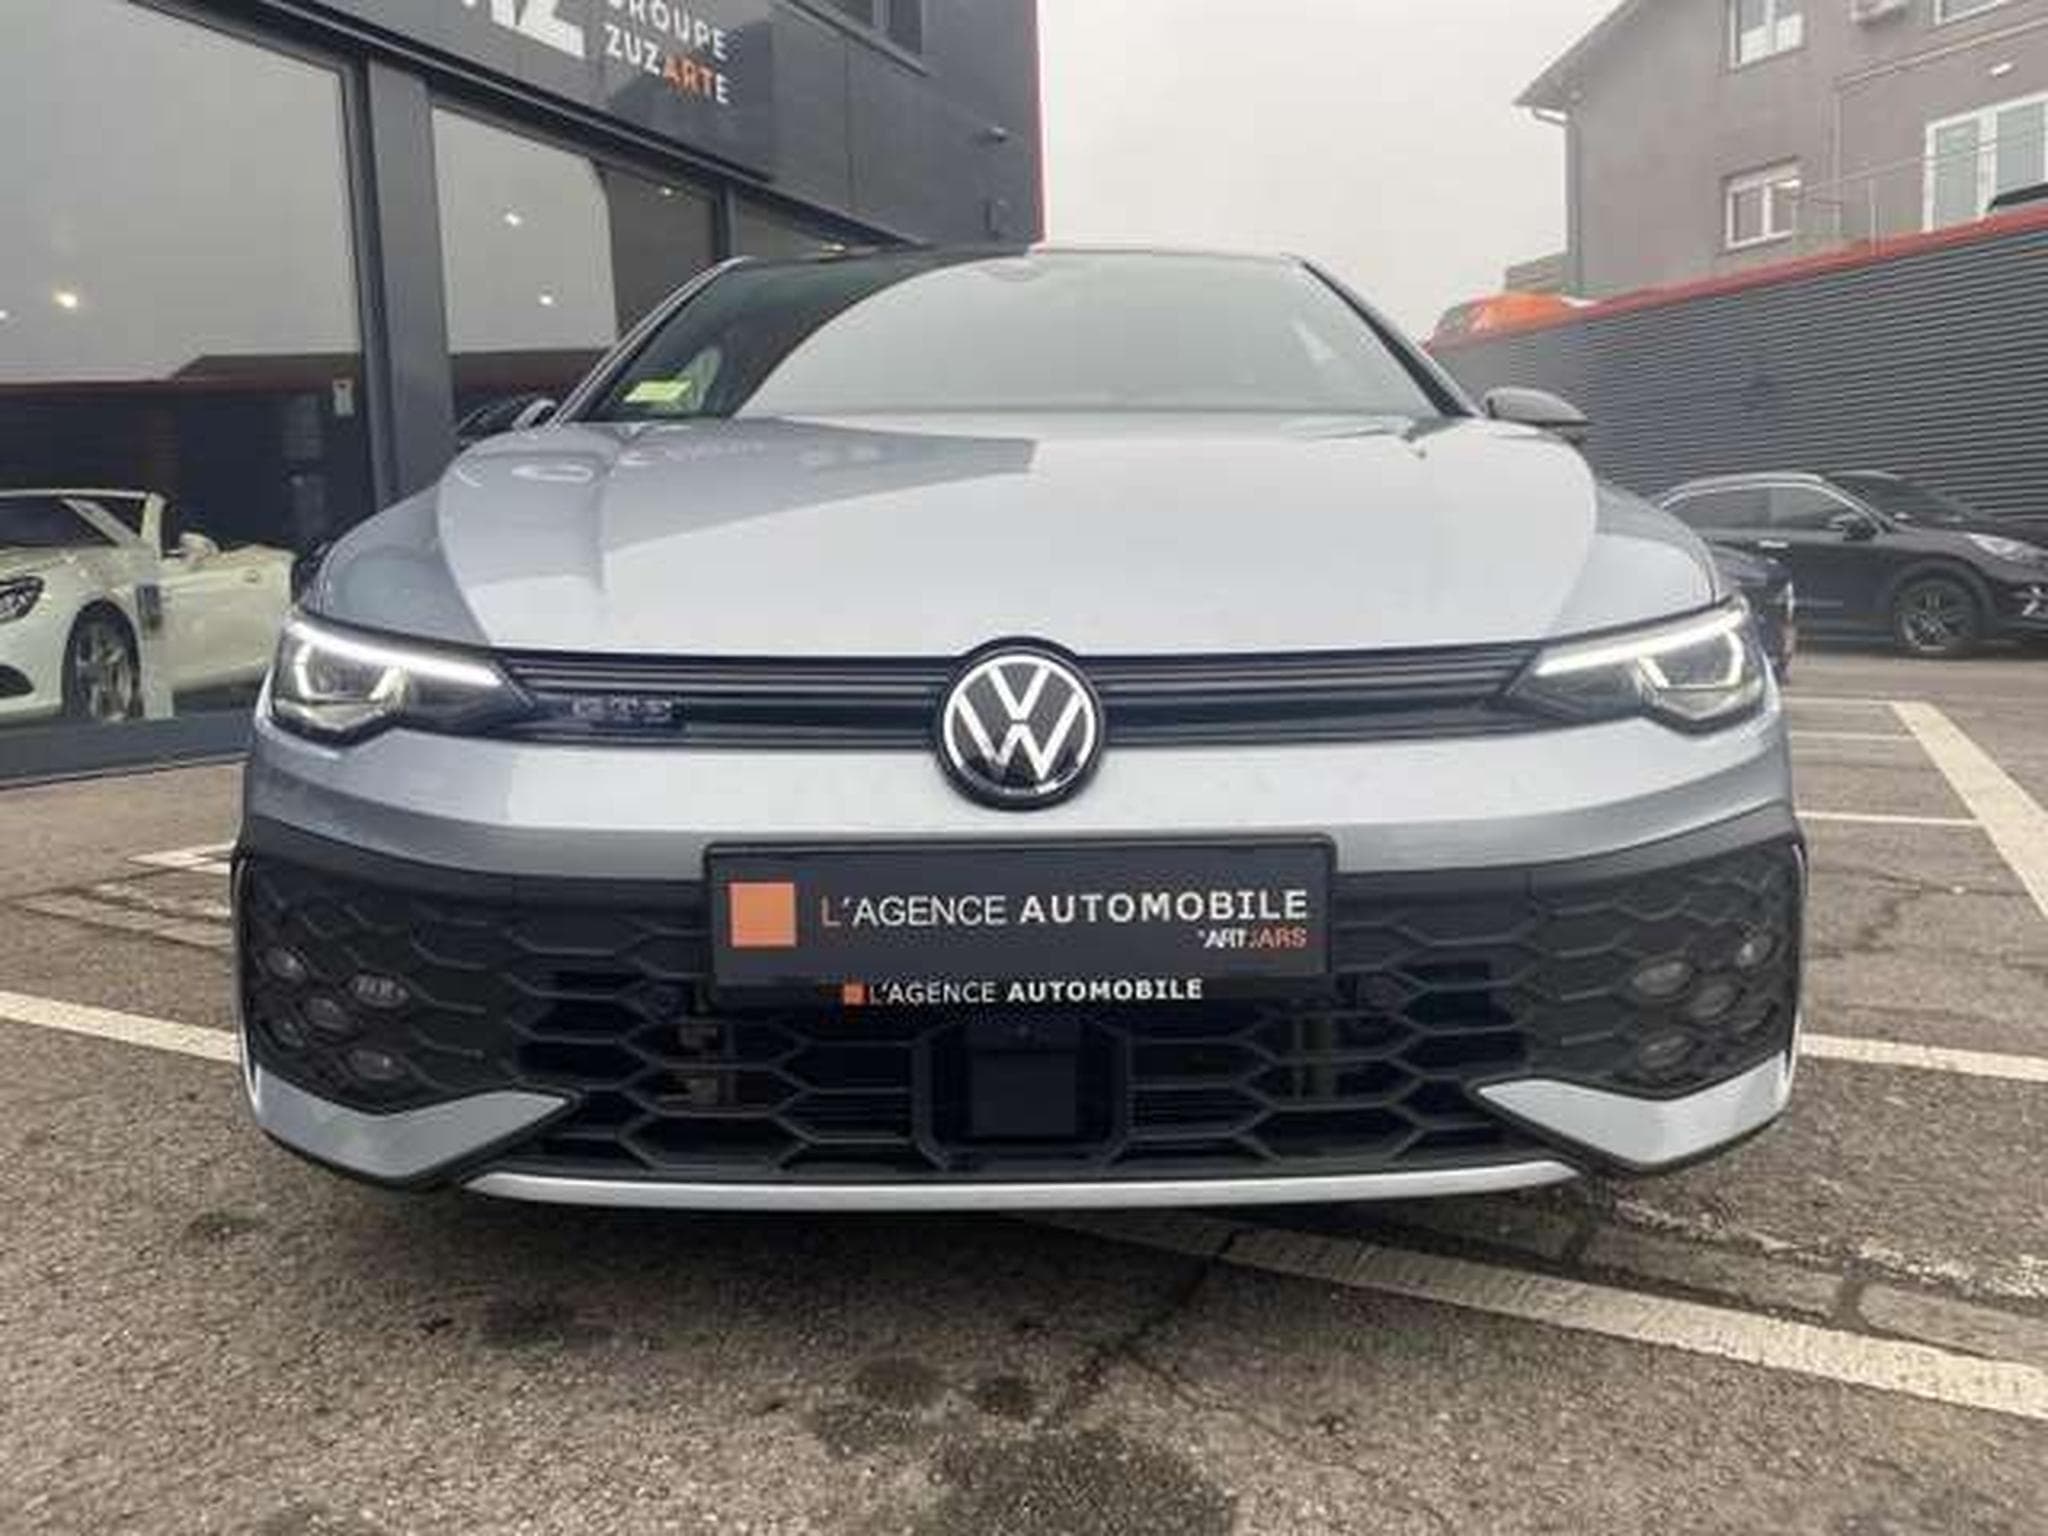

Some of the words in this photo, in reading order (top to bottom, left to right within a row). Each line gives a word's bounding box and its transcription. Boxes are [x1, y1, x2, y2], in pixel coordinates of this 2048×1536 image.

[610, 0, 728, 61] ROUPE
[602, 24, 728, 103] ZUZARTE
[821, 896, 1007, 927] L'AGENCE
[1019, 890, 1307, 924] AUTOMOBILE
[868, 981, 996, 1006] L'AGENCE
[1007, 979, 1204, 1003] AUTOMOBILE
